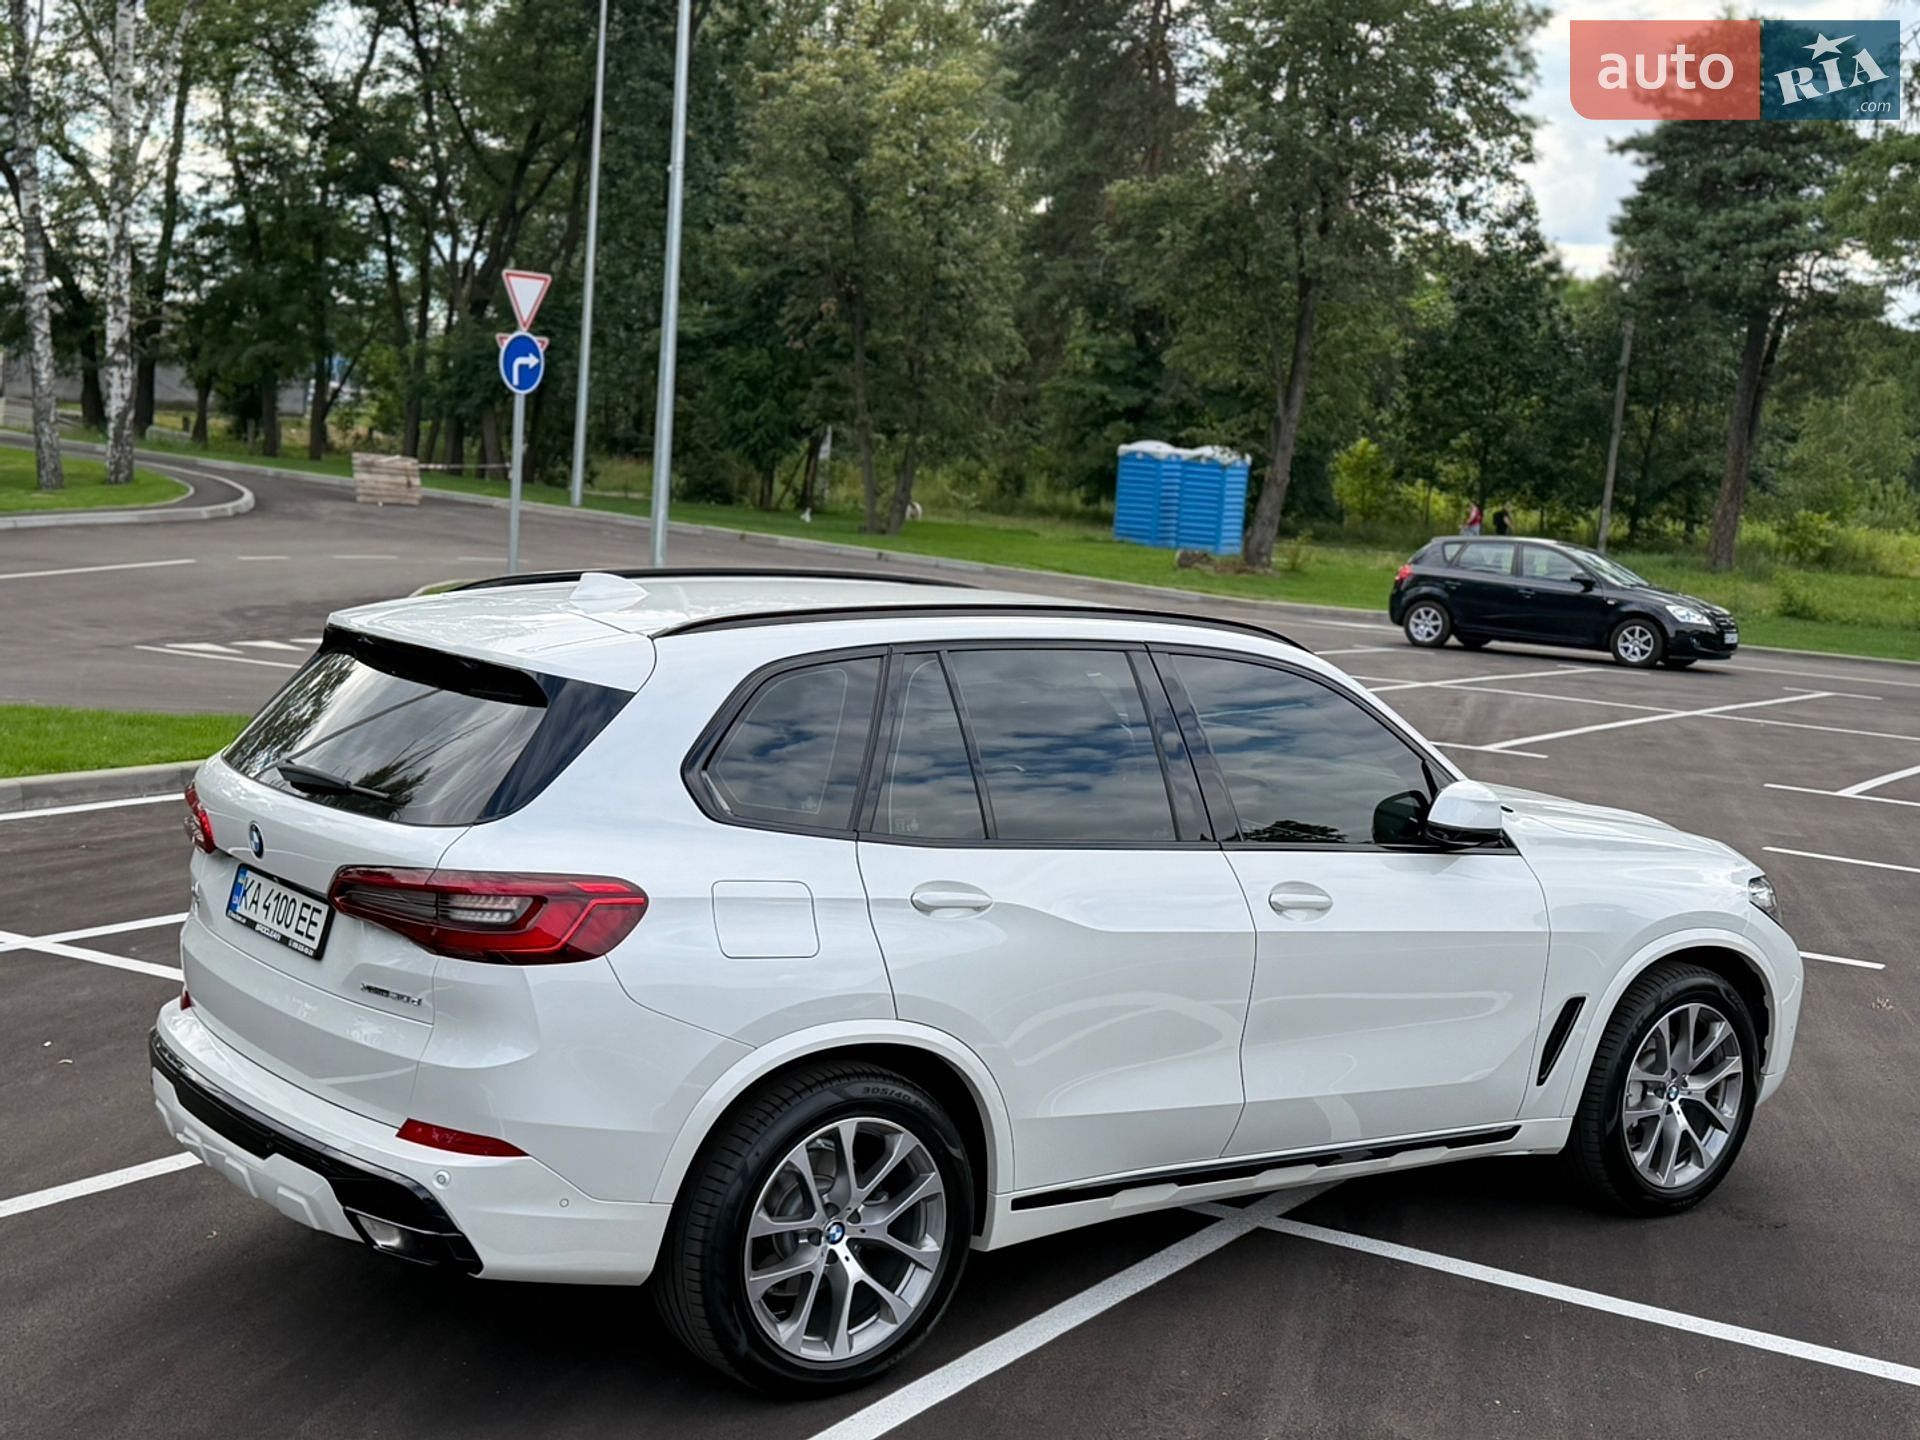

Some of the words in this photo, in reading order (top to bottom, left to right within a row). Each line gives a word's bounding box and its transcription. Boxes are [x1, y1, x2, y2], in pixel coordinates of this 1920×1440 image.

[239, 876, 262, 915] KA
[262, 888, 297, 930] 4100
[294, 901, 323, 942] EE
